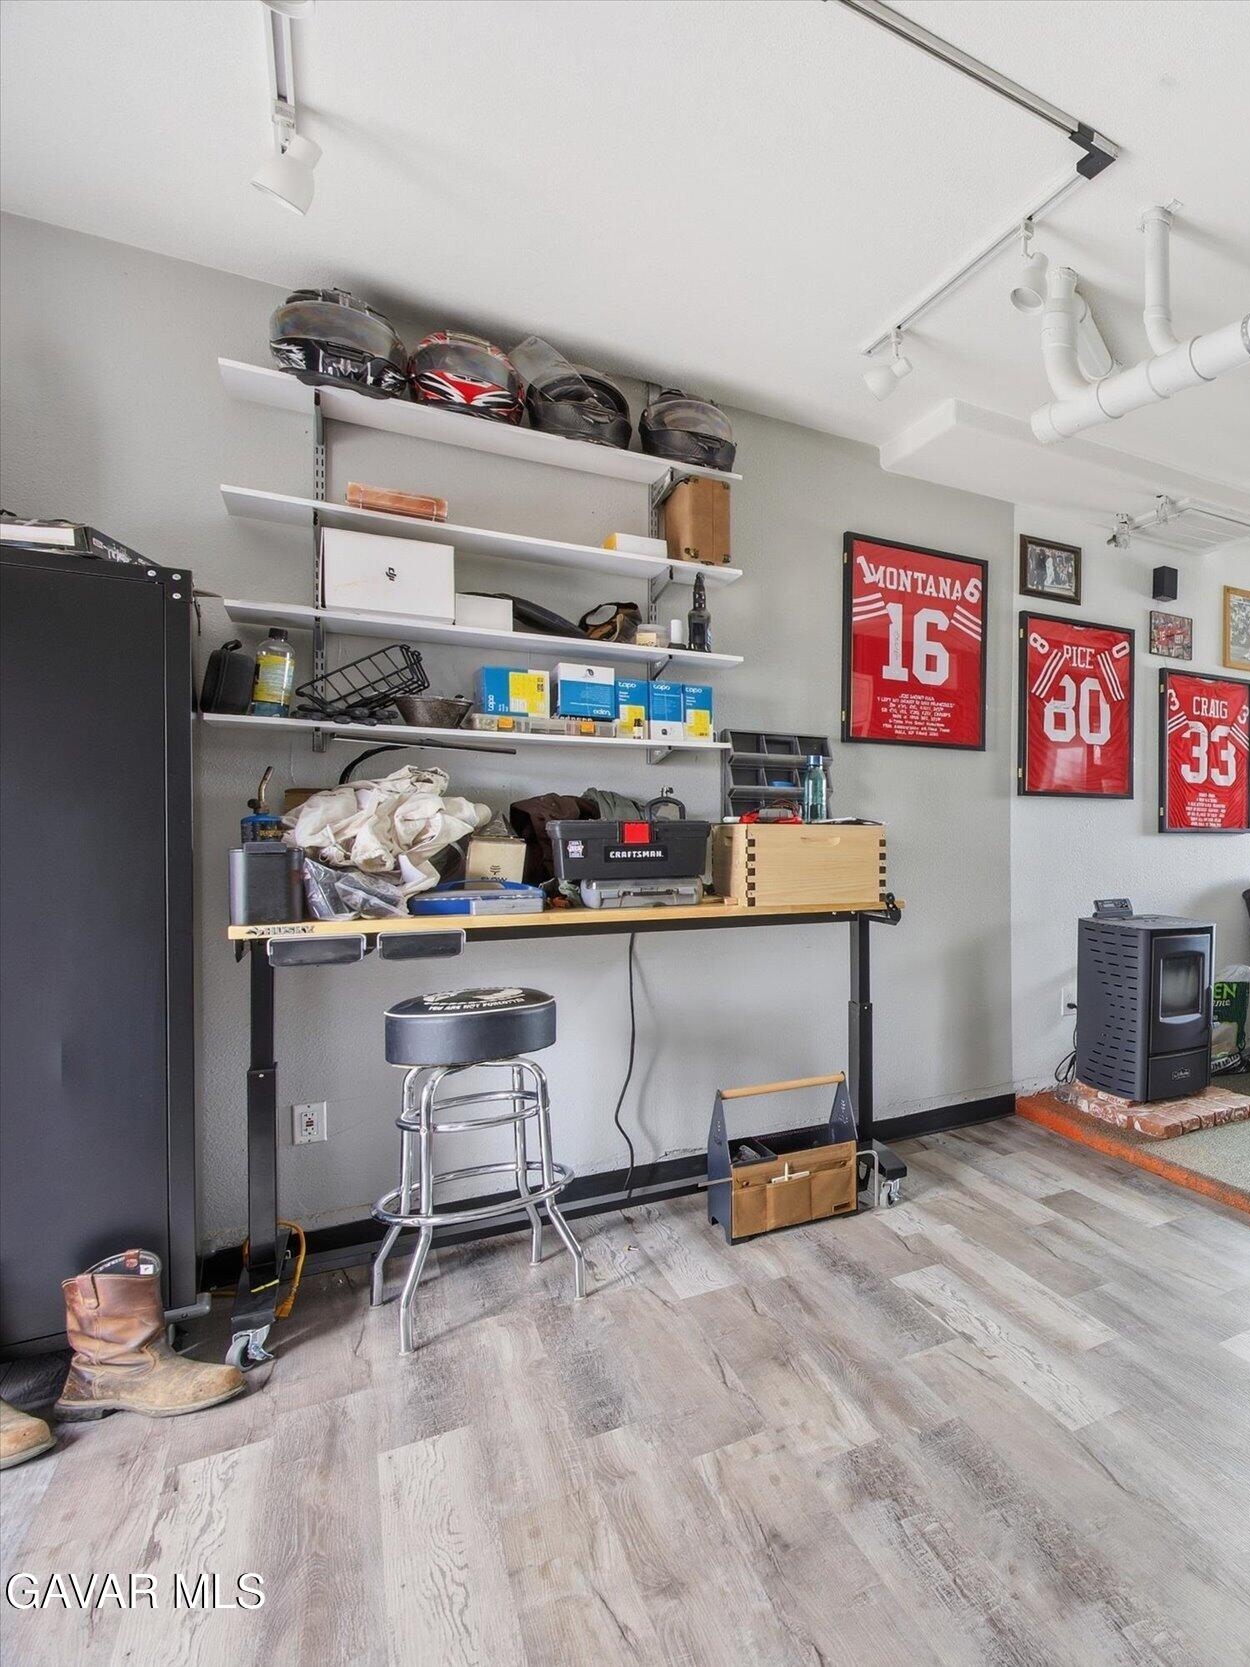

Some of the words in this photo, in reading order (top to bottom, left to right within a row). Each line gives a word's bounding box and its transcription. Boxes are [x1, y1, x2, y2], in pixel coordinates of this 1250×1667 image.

[869, 563, 963, 601] MONTANA
[882, 602, 950, 686] 16
[1063, 645, 1096, 669] RICE
[618, 681, 637, 689] tapo
[1043, 674, 1112, 746] 80
[1193, 696, 1228, 719] CRAIG
[1181, 721, 1237, 787] 33
